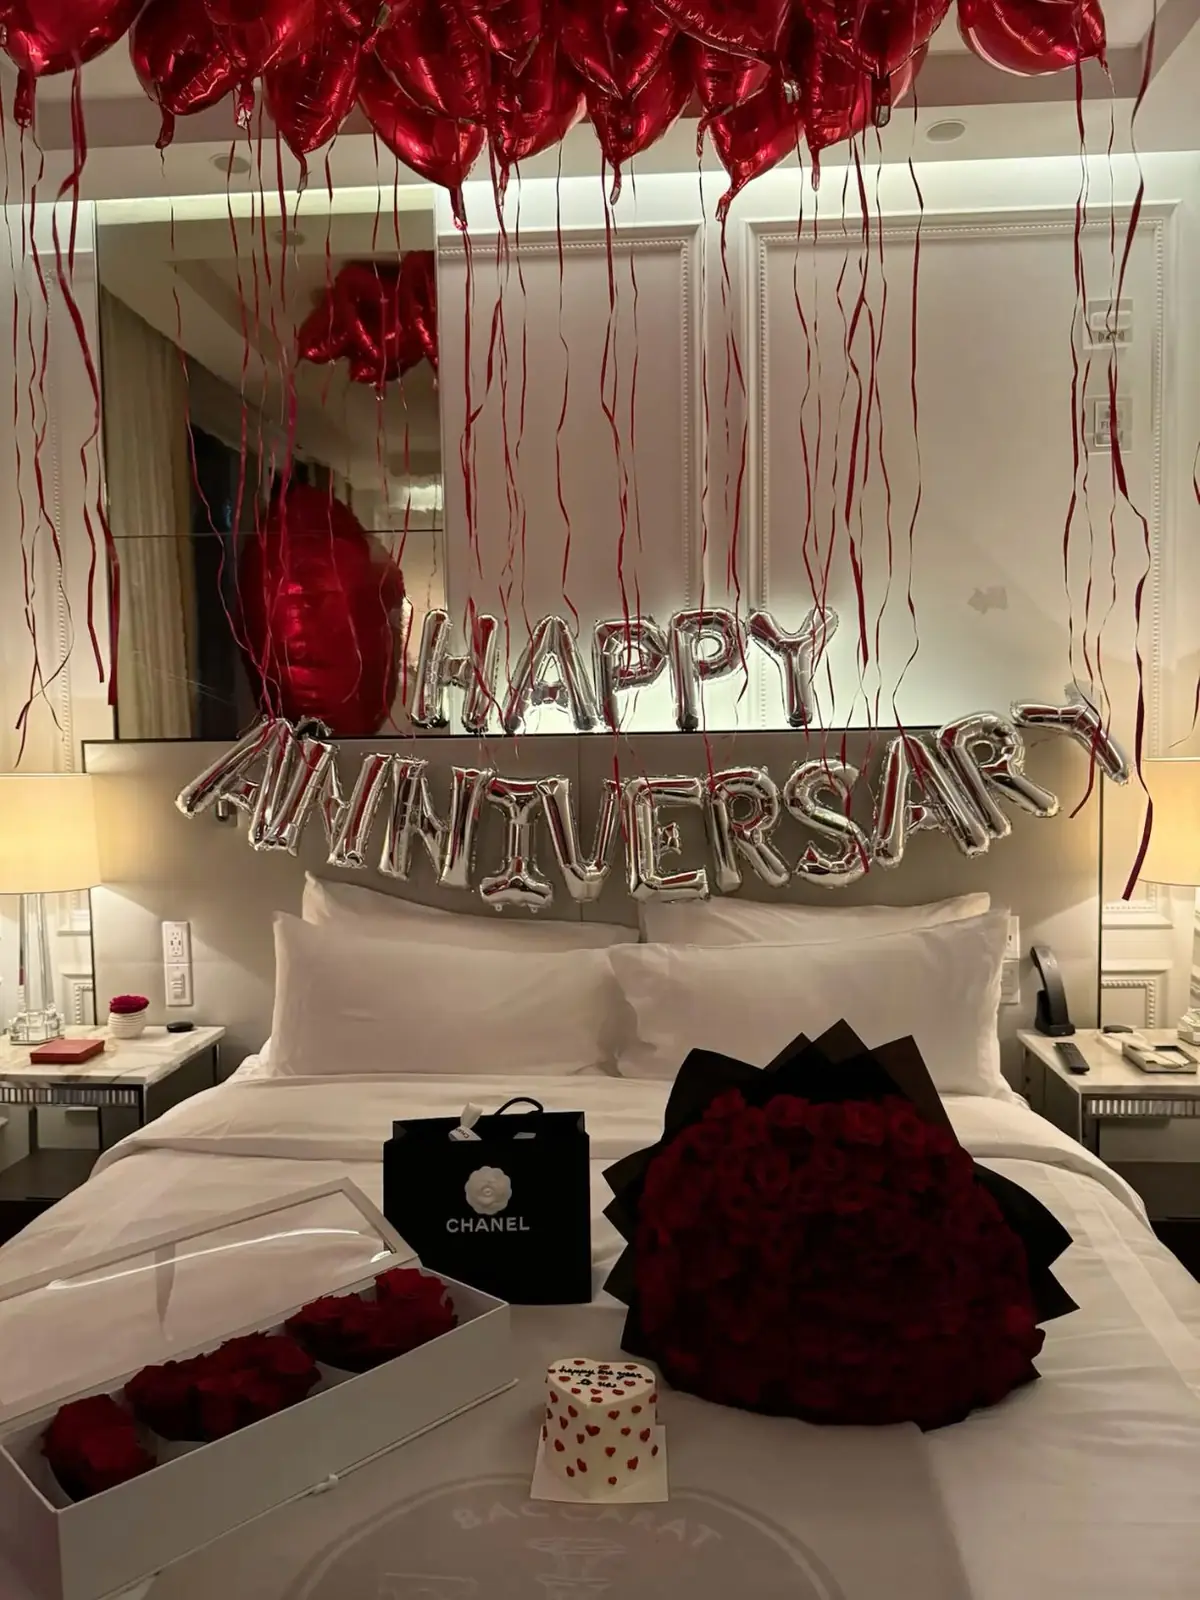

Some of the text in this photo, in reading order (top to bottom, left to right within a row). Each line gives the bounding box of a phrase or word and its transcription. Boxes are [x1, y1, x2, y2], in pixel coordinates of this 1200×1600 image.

[411, 605, 839, 734] HAPPY
[174, 690, 1132, 913] ANNIVERSARY
[446, 1216, 530, 1233] CHANEL
[559, 1366, 595, 1377] happy
